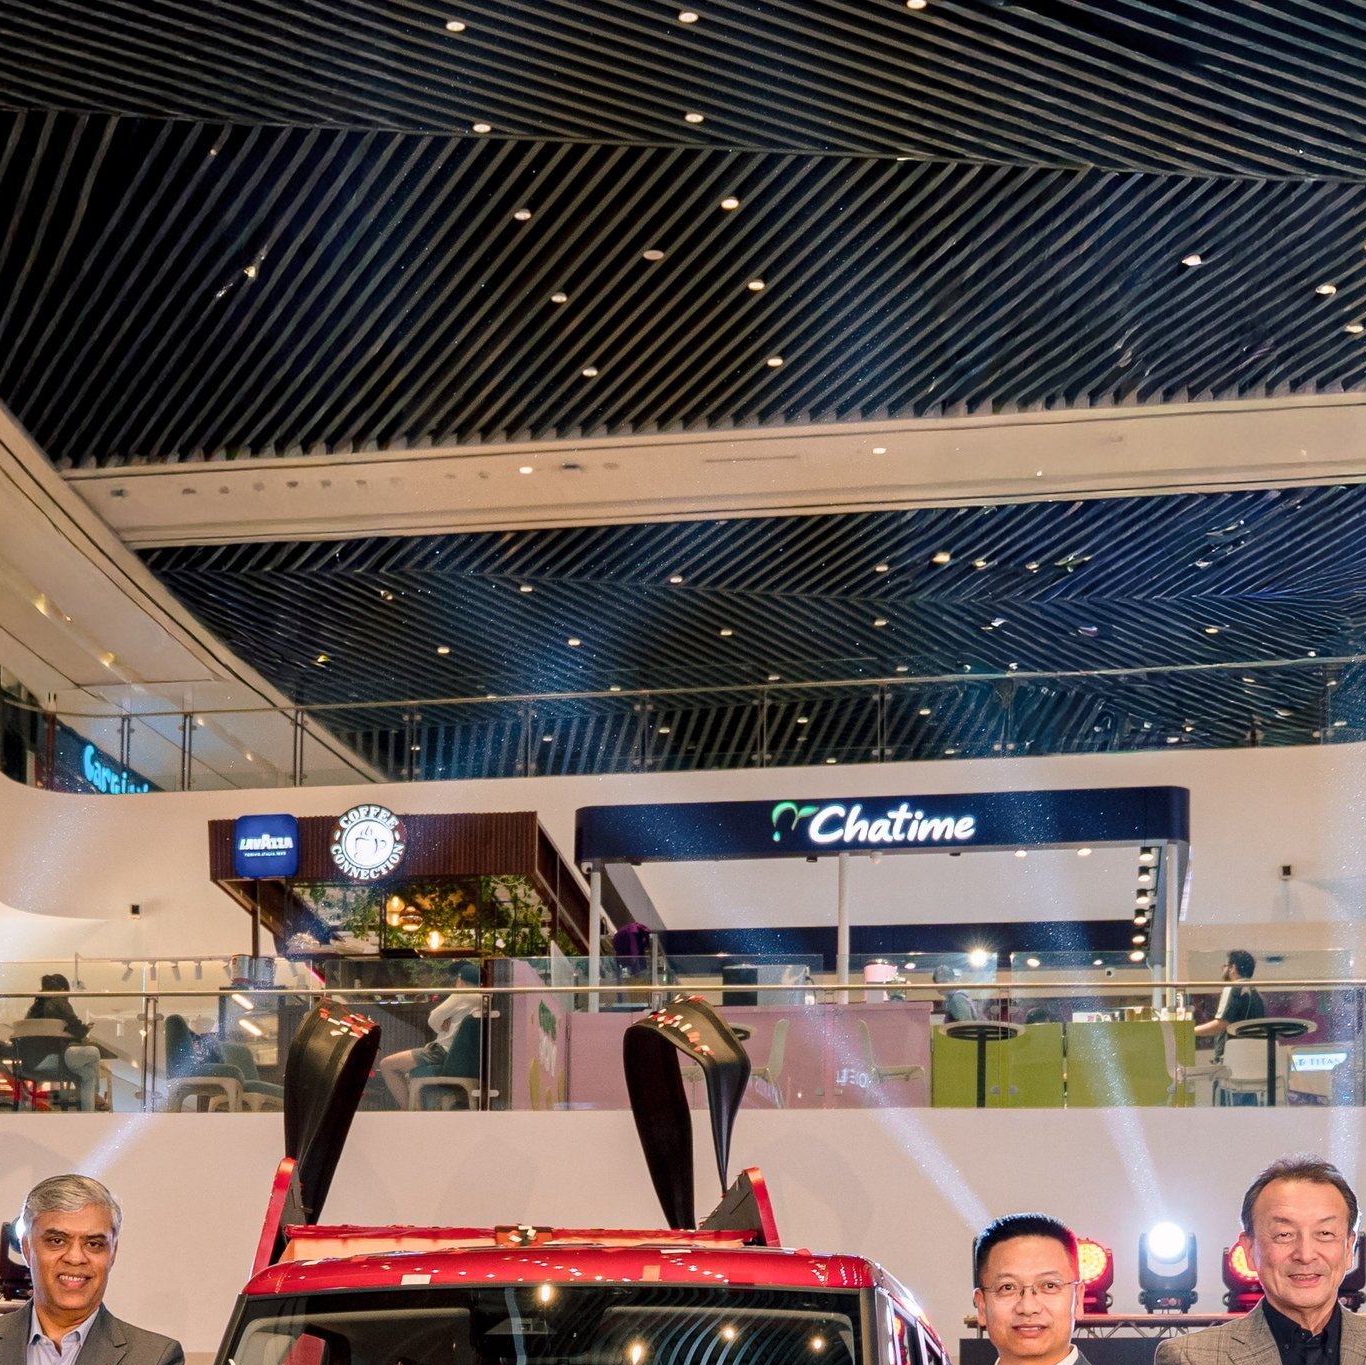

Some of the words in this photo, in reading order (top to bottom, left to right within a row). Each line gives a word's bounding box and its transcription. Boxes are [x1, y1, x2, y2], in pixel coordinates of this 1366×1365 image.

[339, 805, 399, 829] COFFEE
[807, 802, 976, 844] Chatime
[238, 833, 294, 851] LAVAZZA
[330, 842, 405, 881] CONNECTION
